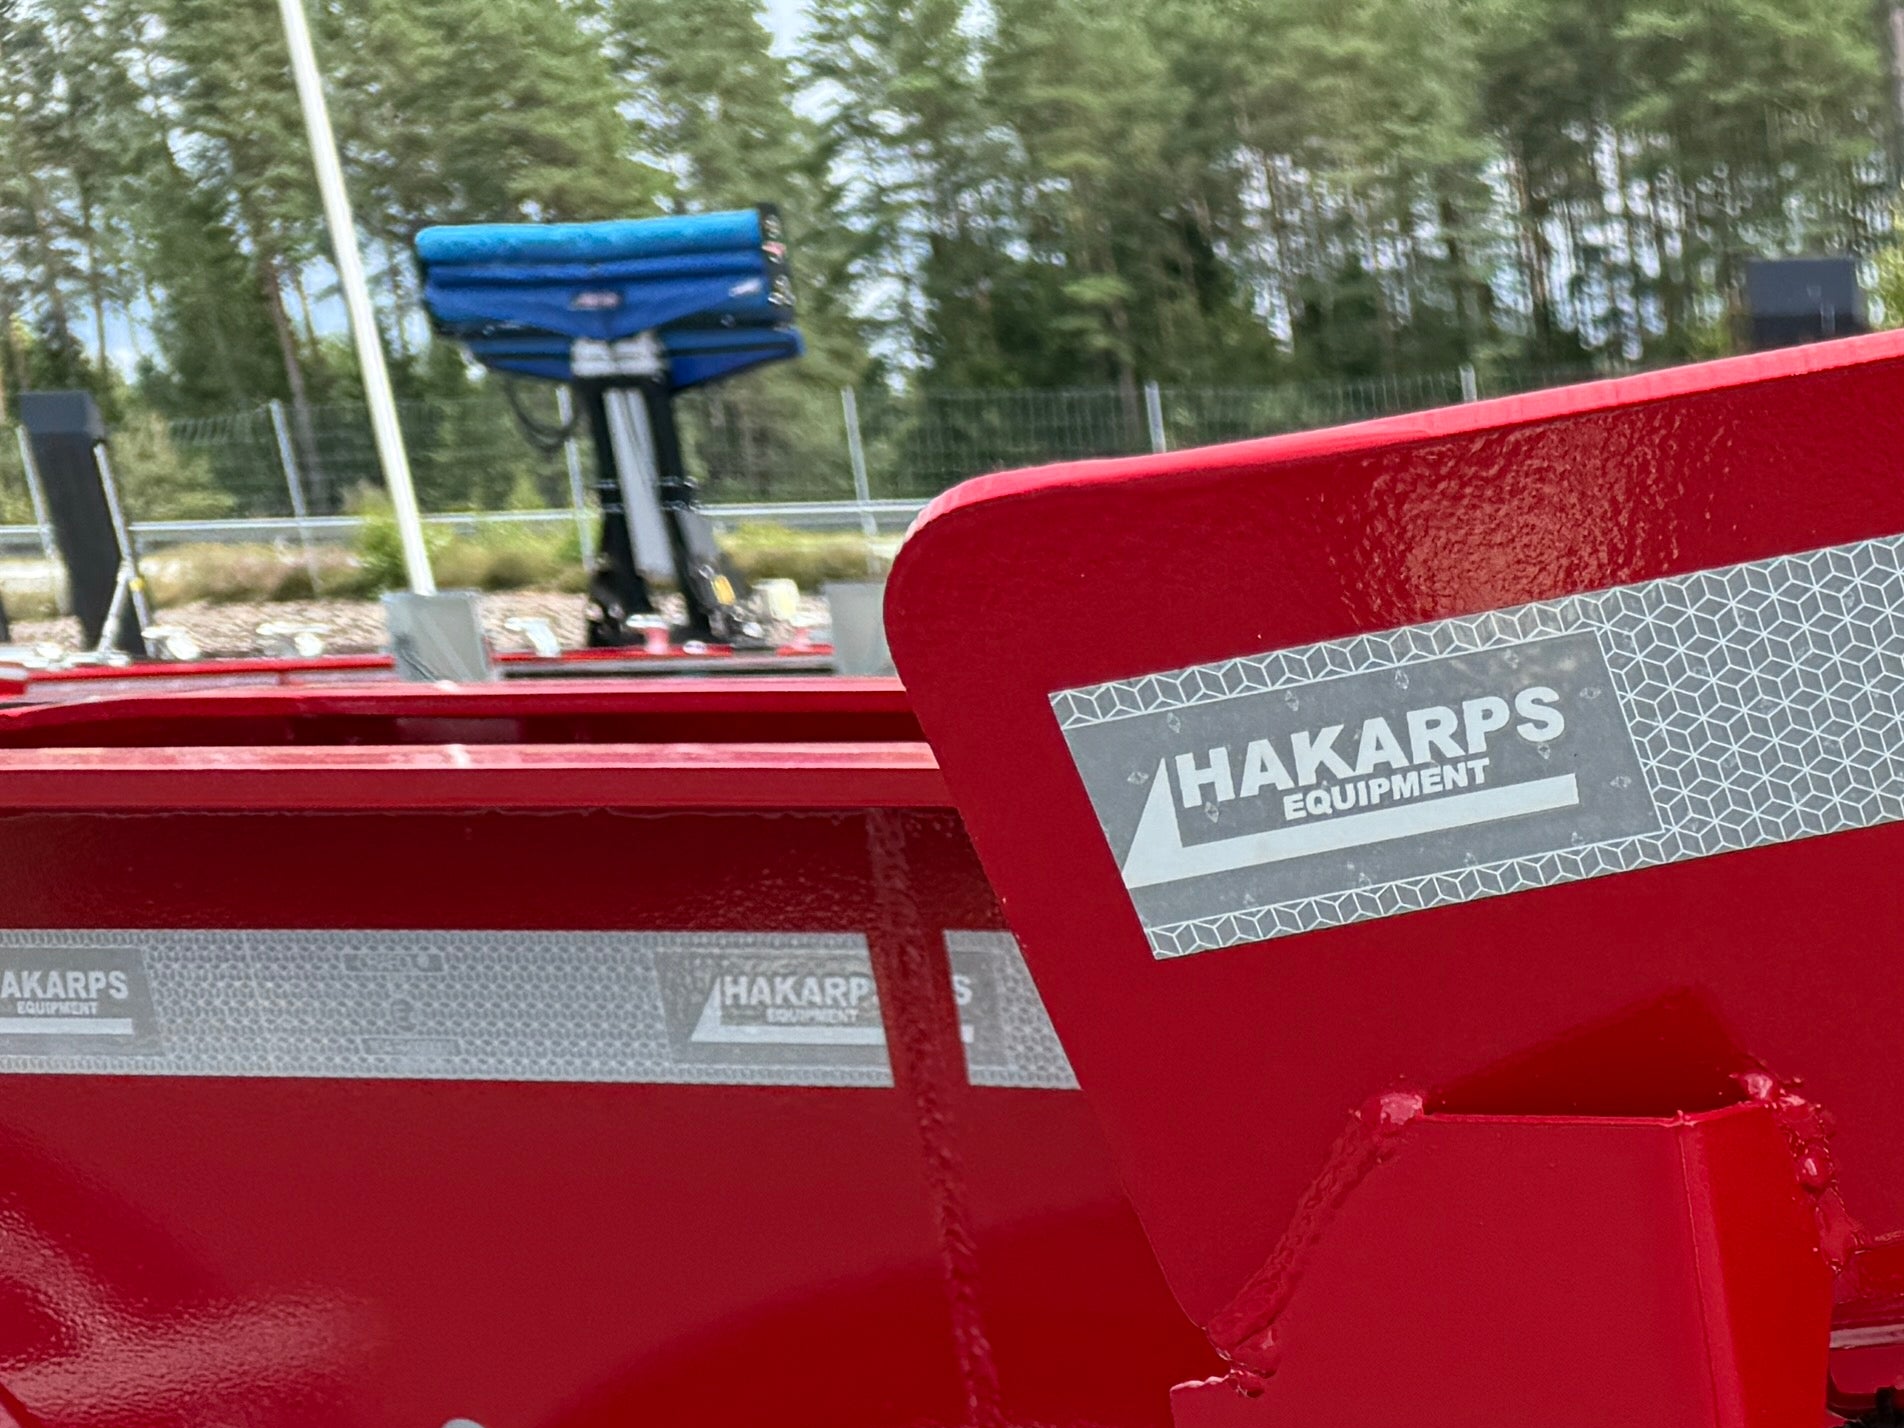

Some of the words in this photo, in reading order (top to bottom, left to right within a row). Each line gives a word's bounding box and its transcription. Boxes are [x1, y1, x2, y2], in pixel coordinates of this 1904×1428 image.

[1175, 686, 1565, 808] HAKARPS
[1283, 757, 1490, 821] EQUIPMENT
[16, 1001, 98, 1015] EQUIPMENT
[766, 1007, 859, 1024] EQUIPMENT
